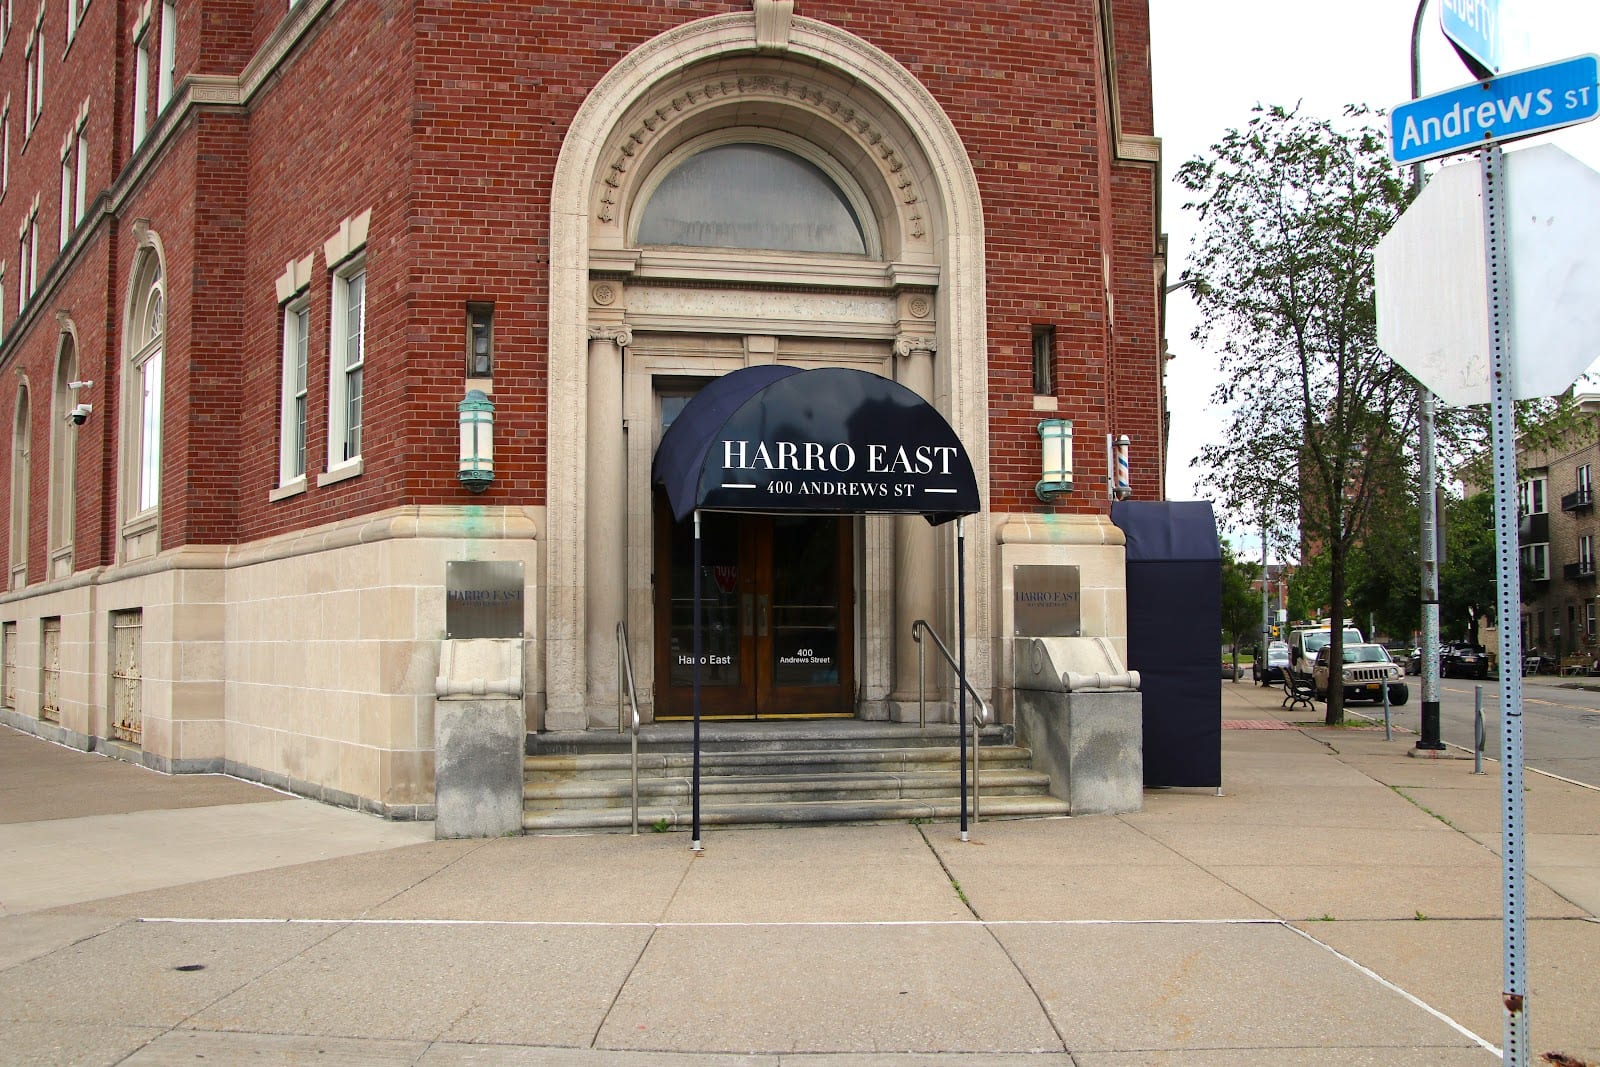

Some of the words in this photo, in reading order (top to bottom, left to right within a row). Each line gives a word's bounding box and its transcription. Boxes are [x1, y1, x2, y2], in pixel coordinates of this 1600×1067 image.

[1401, 88, 1552, 150] Andrews
[1565, 87, 1590, 109] ST
[721, 440, 856, 472] HARRO
[866, 444, 957, 475] EAST
[766, 480, 793, 494] 400
[798, 481, 888, 497] ANDREWS
[894, 483, 915, 497] ST
[447, 590, 489, 600] HARRO
[1016, 592, 1051, 601] HARRO
[678, 656, 707, 665] Haro
[709, 655, 731, 665] East
[779, 656, 809, 664] Andrews
[810, 656, 830, 664] Street
